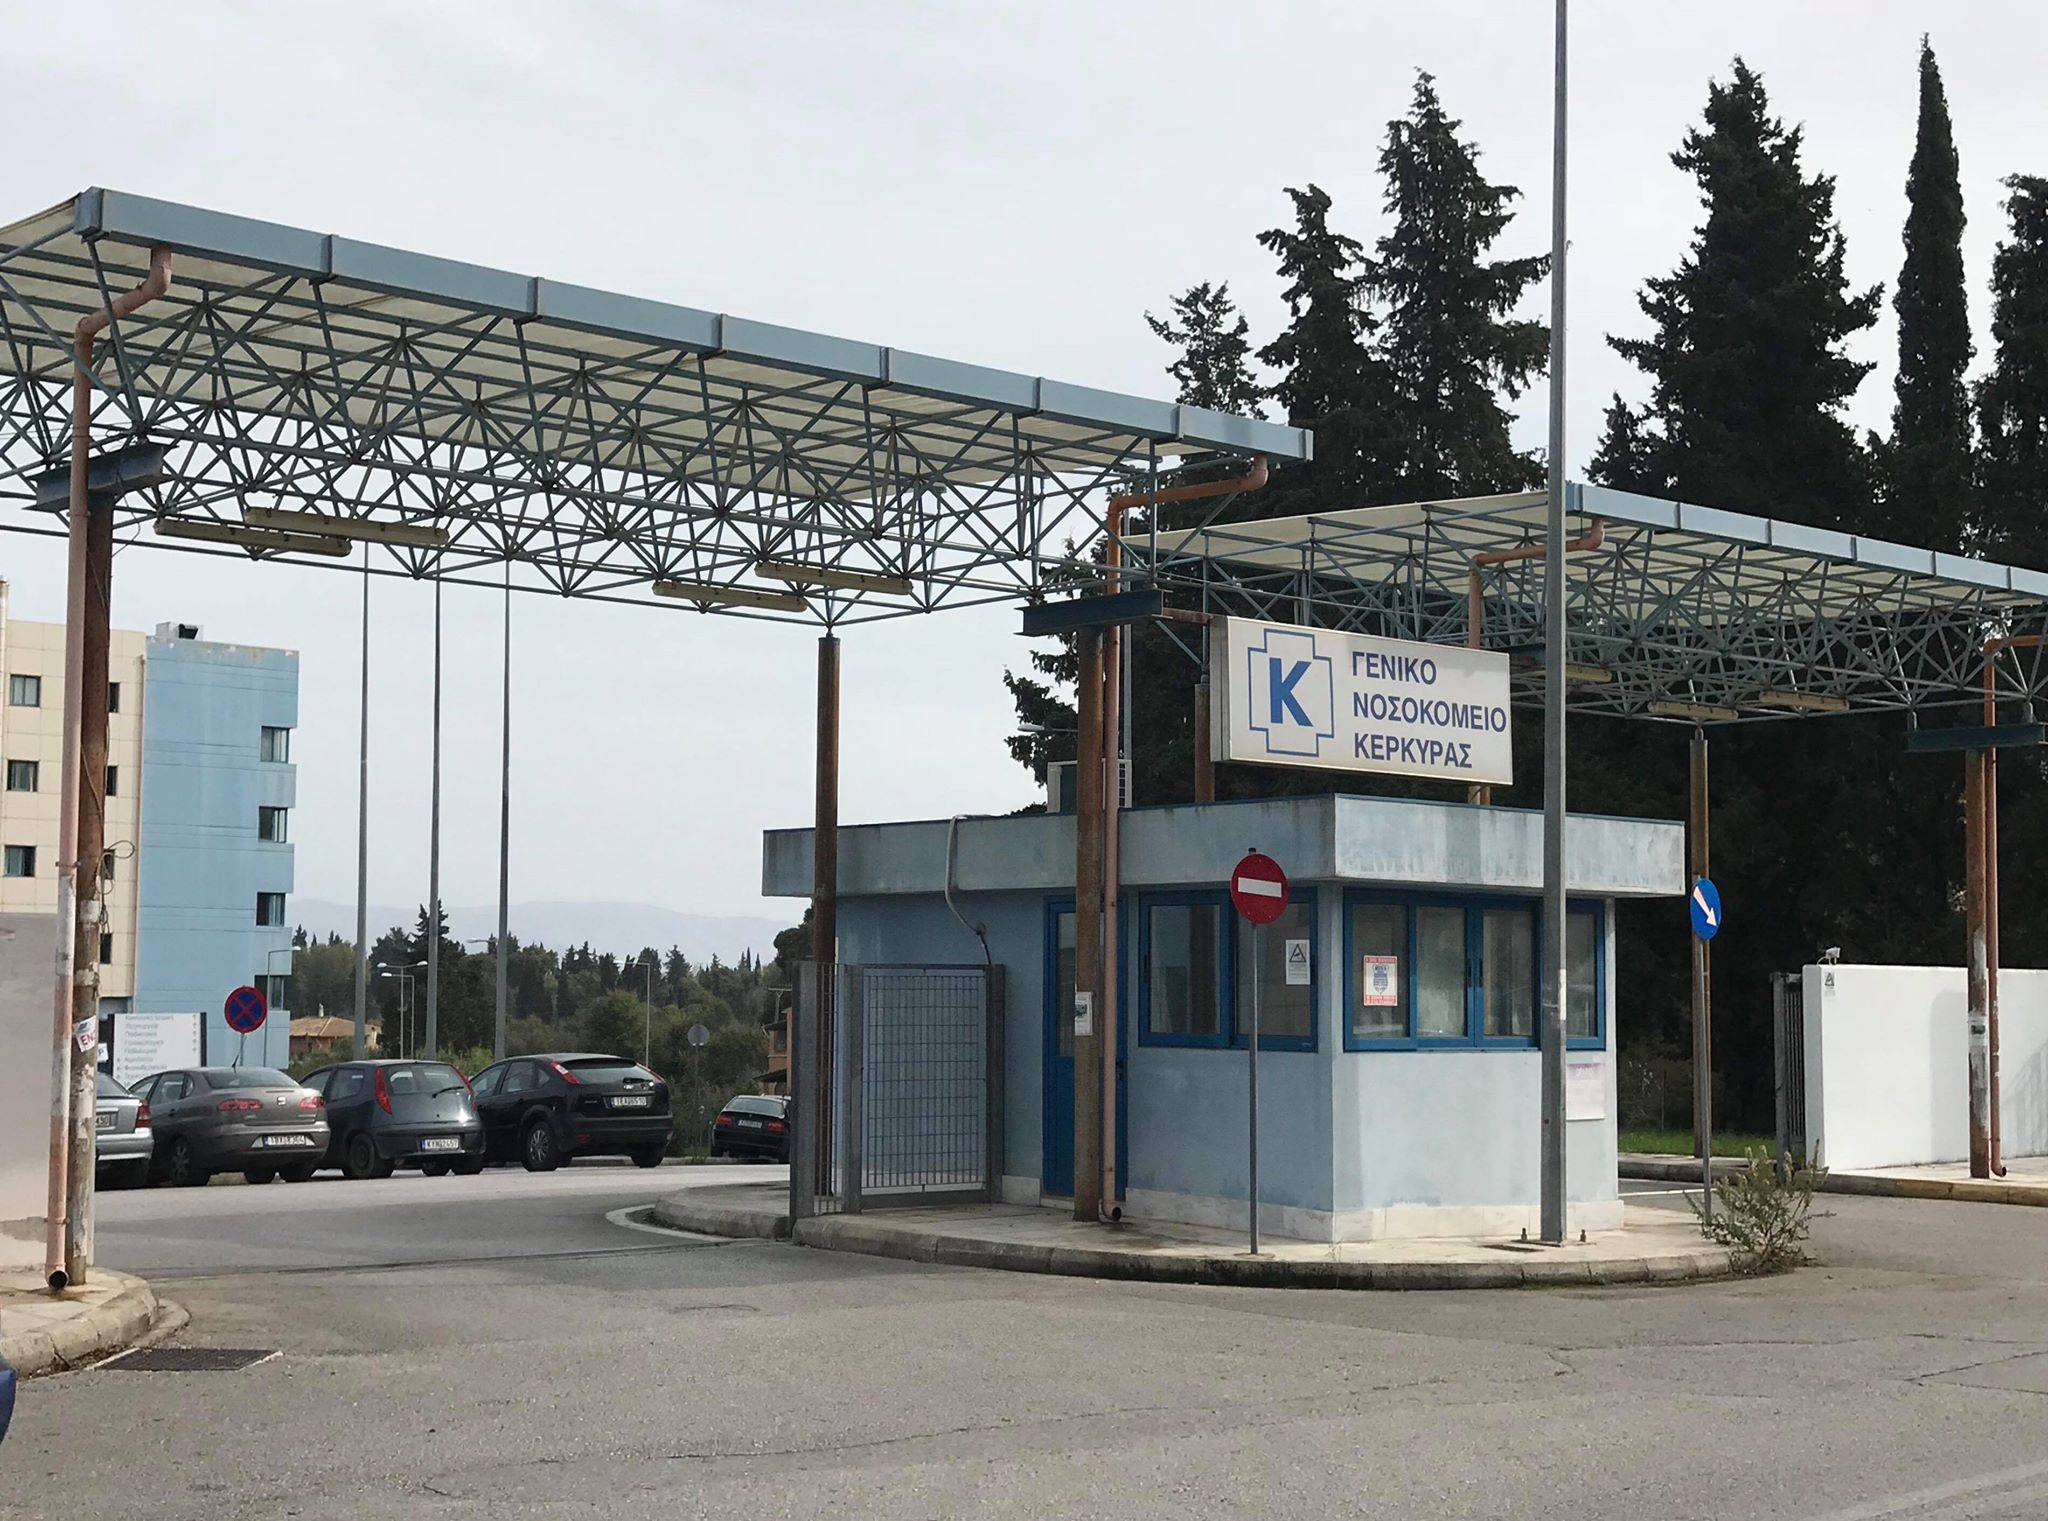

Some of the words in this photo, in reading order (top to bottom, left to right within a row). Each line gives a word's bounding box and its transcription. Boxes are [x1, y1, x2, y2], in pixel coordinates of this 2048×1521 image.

[1352, 651, 1437, 686] ΓΕΝΙΚΟ
[1269, 656, 1314, 728] Κ
[1353, 691, 1507, 733] ΝΟΣΟΚΟΜΕΙΟ
[1354, 732, 1473, 769] ΚΕΡΚΥΡΑΣ
